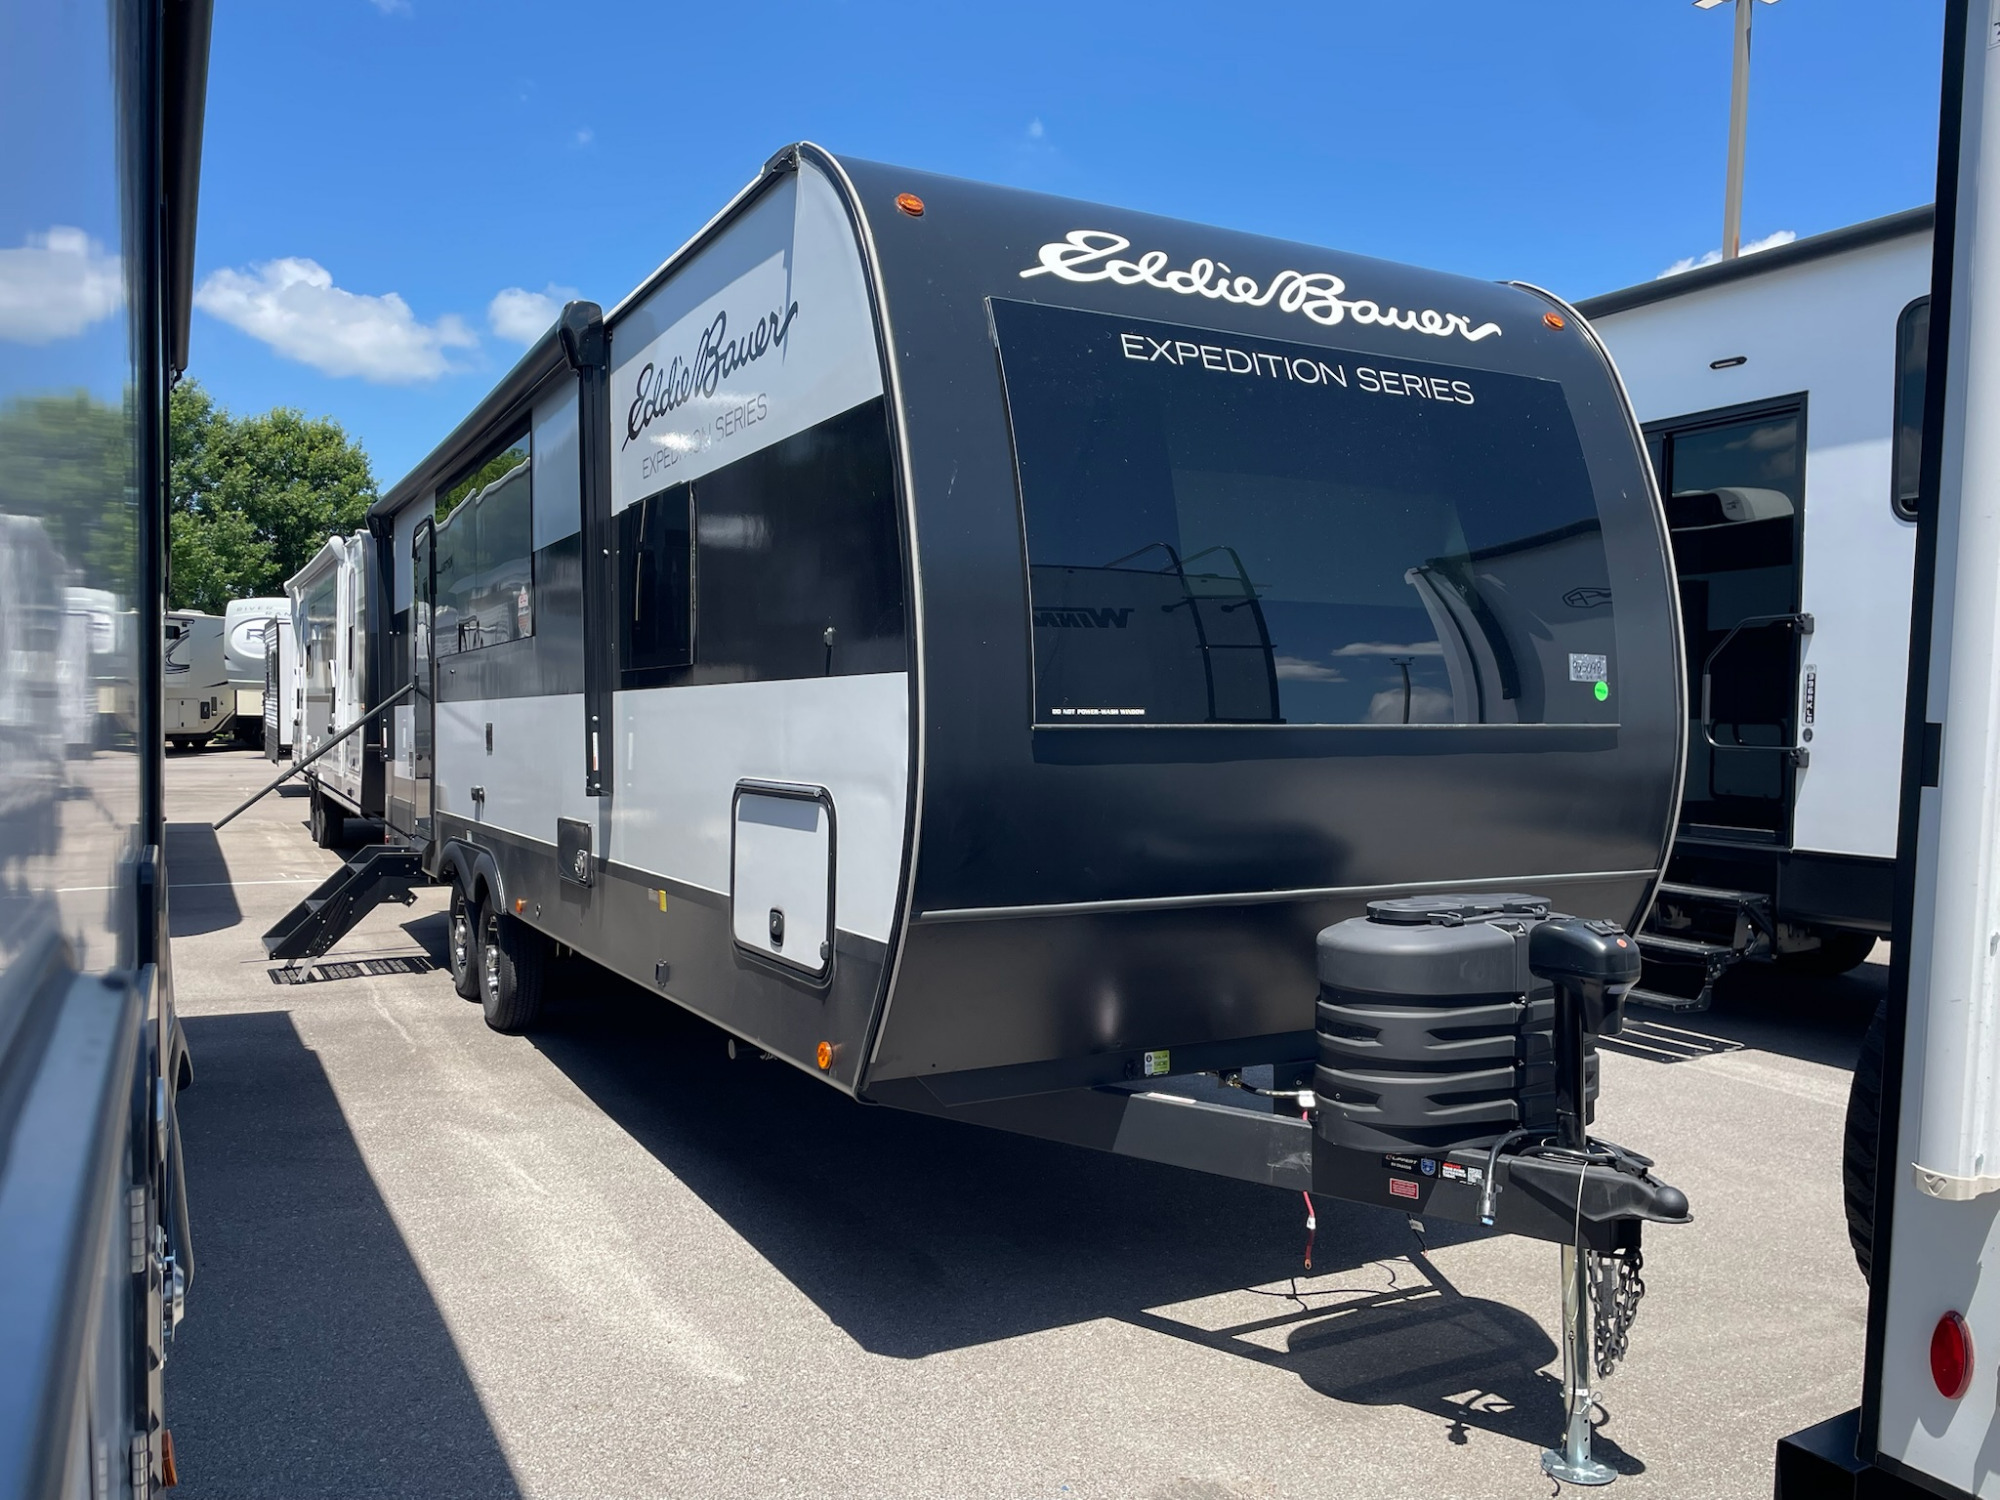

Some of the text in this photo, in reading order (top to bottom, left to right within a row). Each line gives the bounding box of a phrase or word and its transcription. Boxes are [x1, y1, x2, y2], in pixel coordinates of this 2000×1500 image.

[1019, 229, 1503, 342] Eddie Bauer
[622, 300, 799, 452] Eddie Bauer
[1120, 333, 1476, 405] EXPEDITION SERIES
[715, 392, 768, 442] SERIES
